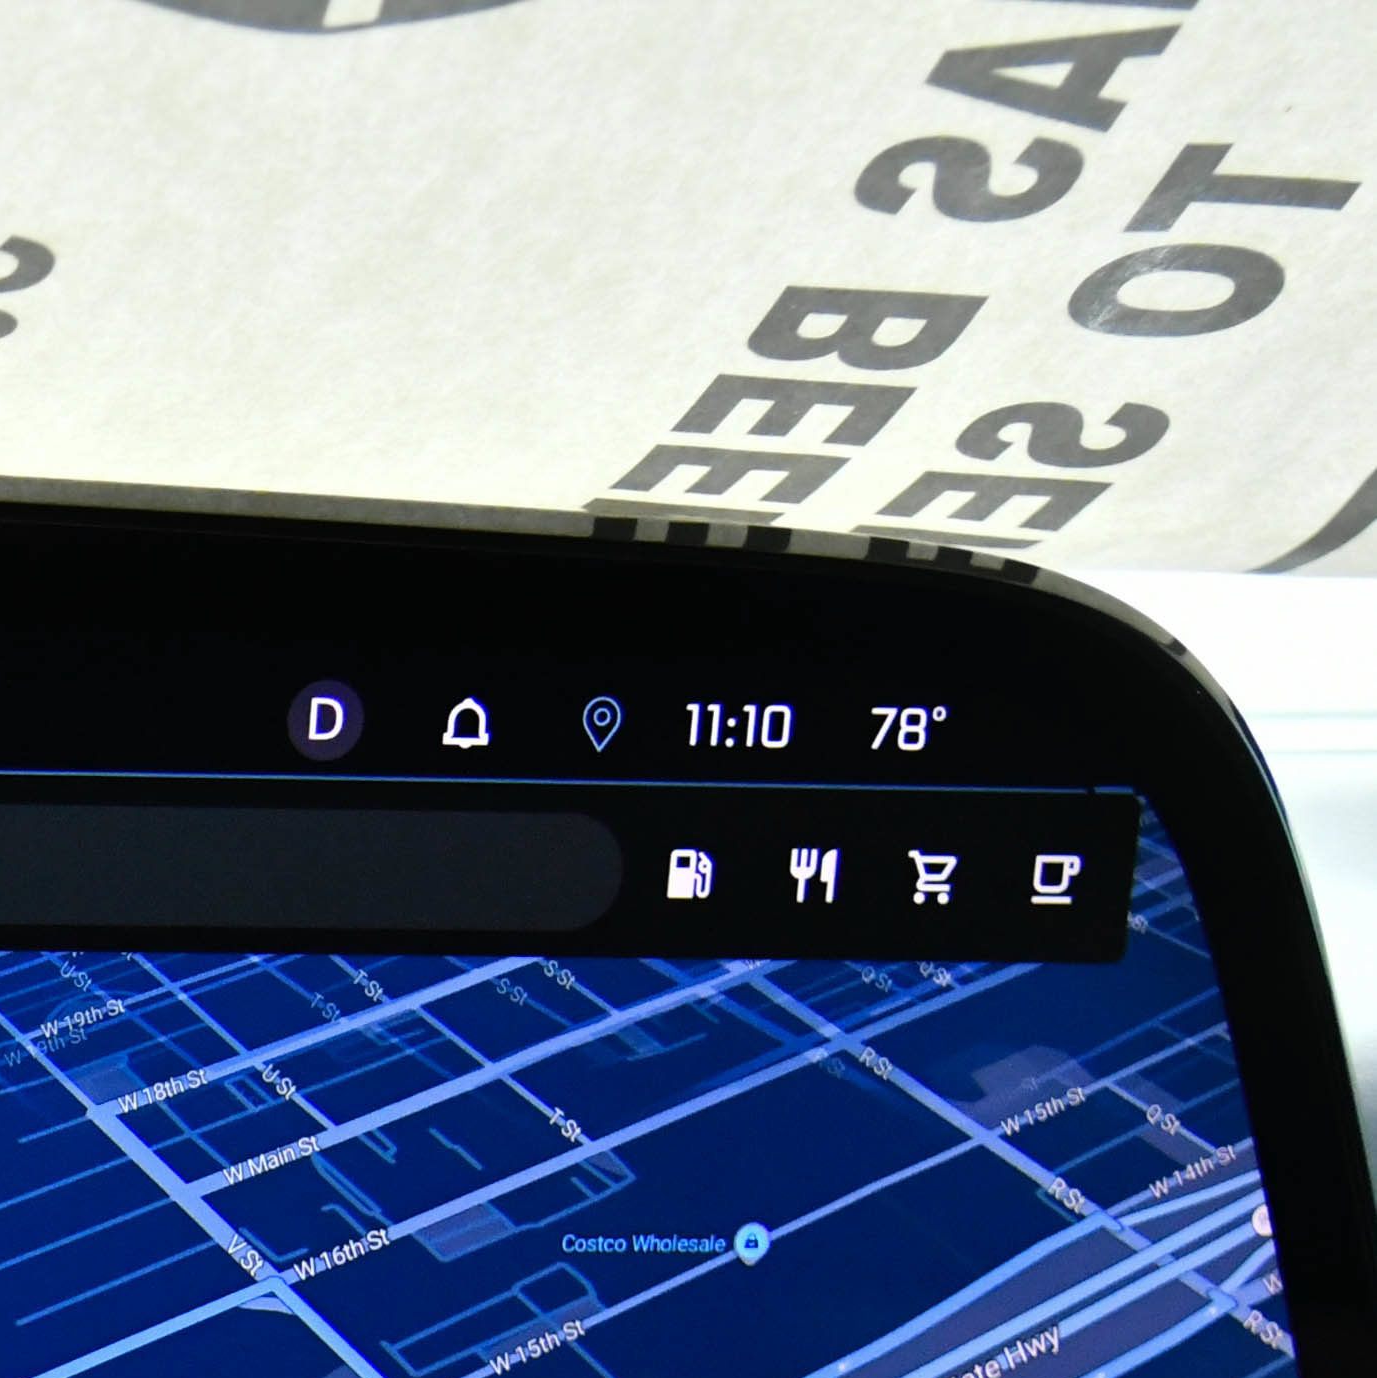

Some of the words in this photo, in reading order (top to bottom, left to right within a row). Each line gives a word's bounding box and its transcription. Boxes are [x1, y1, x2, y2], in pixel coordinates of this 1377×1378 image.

[308, 696, 343, 742] D
[686, 703, 793, 749] 11:10
[869, 705, 949, 753] 78°
[59, 961, 75, 978] U
[71, 971, 93, 993] St
[354, 968, 370, 988] T
[362, 977, 386, 1004] St
[507, 984, 529, 1006] St
[556, 969, 576, 990] St
[875, 974, 894, 993] St
[41, 1018, 60, 1039] W
[62, 1005, 104, 1033] 19th
[105, 997, 126, 1018] St
[321, 1000, 343, 1023] St
[261, 1063, 280, 1084] U
[273, 1077, 298, 1101] St
[859, 1046, 877, 1065] R
[871, 1056, 895, 1081] St
[118, 1092, 140, 1114] W
[143, 1076, 184, 1106] 18th
[185, 1067, 209, 1089] St
[549, 1107, 567, 1126] T
[559, 1118, 582, 1143] St
[1001, 1113, 1021, 1138] W
[1024, 1096, 1065, 1131] 15th
[1065, 1086, 1089, 1111] St
[1145, 1102, 1164, 1123] Q
[1157, 1110, 1183, 1136] St
[223, 1163, 246, 1185] W
[247, 1144, 296, 1178] Main
[297, 1134, 321, 1159] St
[1149, 1175, 1170, 1200] W
[1170, 1155, 1216, 1189] 14th
[1215, 1144, 1239, 1168] St
[1047, 1175, 1068, 1198] R
[1062, 1186, 1088, 1214] St
[227, 1233, 243, 1258] V
[240, 1251, 266, 1278] St
[293, 1257, 317, 1282] W
[319, 1234, 364, 1270] 16th
[365, 1225, 392, 1251] St
[561, 1232, 627, 1255] Costco
[631, 1232, 727, 1255] Wholesale
[489, 1354, 511, 1377] W
[513, 1331, 561, 1364] 15th
[561, 1317, 587, 1343] St
[1002, 1322, 1062, 1372] Hwy
[1243, 1310, 1263, 1332] R
[1258, 1321, 1284, 1350] St
